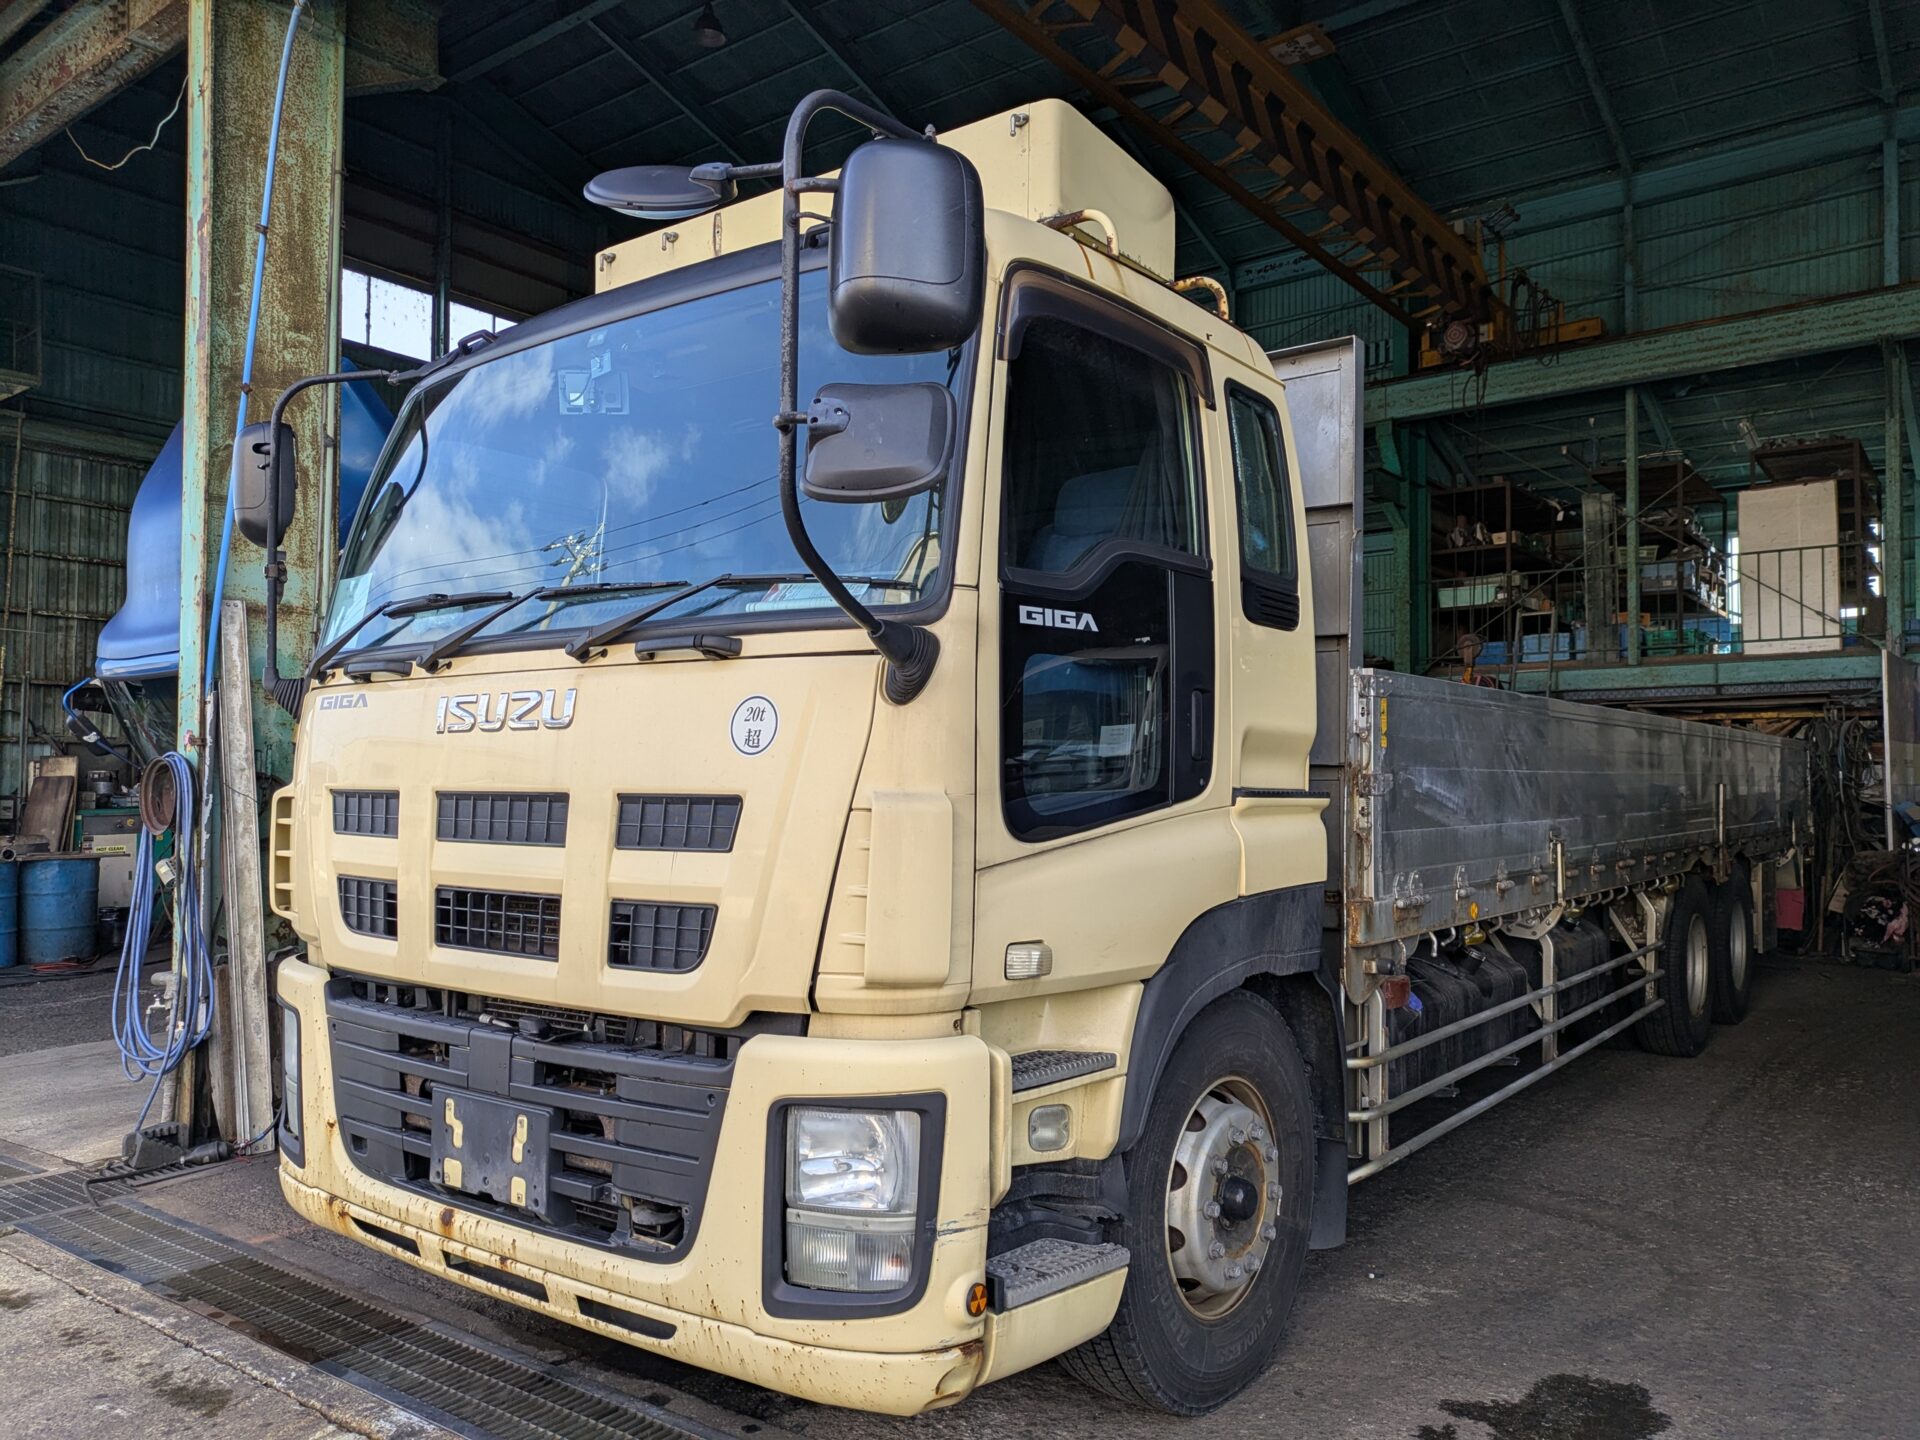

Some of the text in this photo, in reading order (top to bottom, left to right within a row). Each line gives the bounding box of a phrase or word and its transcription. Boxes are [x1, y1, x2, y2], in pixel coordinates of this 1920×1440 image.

[1019, 604, 1099, 632] GIGA
[319, 693, 368, 711] GIGA
[436, 688, 577, 734] ISUZU
[744, 706, 766, 722] 20t
[743, 728, 762, 748] 超
